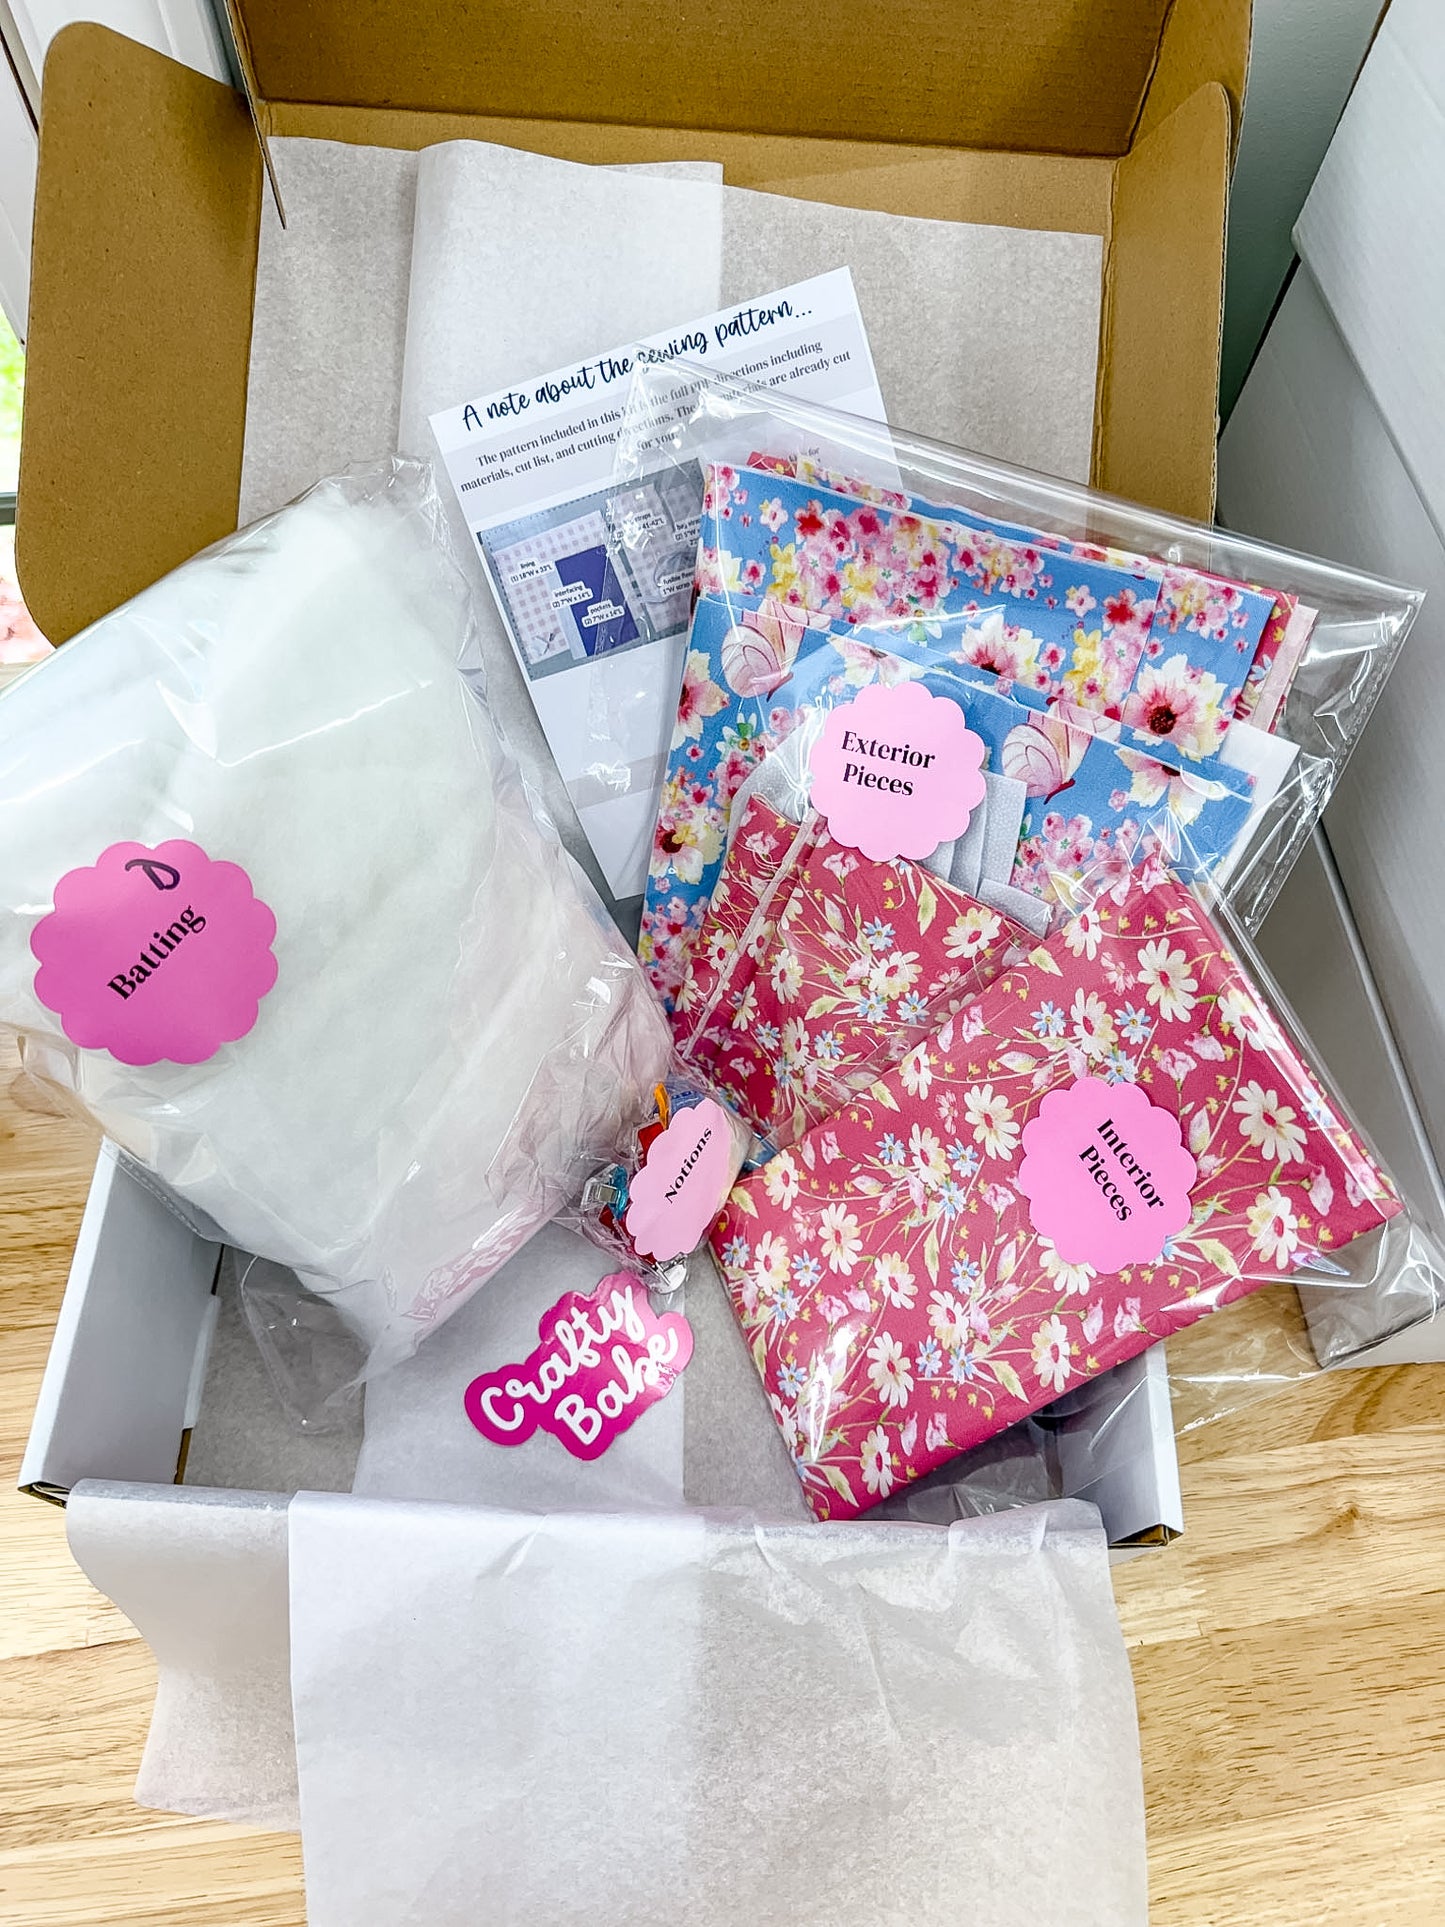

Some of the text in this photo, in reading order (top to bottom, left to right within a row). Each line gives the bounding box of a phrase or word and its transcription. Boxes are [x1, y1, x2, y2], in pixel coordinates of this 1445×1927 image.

[460, 467, 514, 493] materials,
[515, 459, 532, 474] cut
[533, 452, 554, 469] list,
[556, 443, 576, 460] and
[577, 431, 616, 453] cutting
[769, 373, 787, 387] are
[789, 357, 831, 380] already
[833, 350, 851, 365] cut
[462, 404, 483, 431] A
[487, 392, 530, 419] note
[535, 366, 595, 404] about
[594, 358, 633, 383] the
[475, 451, 498, 467] The
[499, 438, 540, 463] pattern
[540, 420, 587, 446] included
[588, 417, 599, 430] in
[600, 409, 621, 425] this
[670, 384, 689, 401] full
[770, 341, 823, 366] including
[554, 584, 583, 598] interfacing
[841, 730, 936, 769] Exterior
[842, 763, 914, 796] Pieces
[124, 858, 181, 891] D
[106, 904, 207, 1000] Batting
[664, 1126, 712, 1204] Notions
[1078, 1144, 1132, 1222] Pieces
[1096, 1118, 1165, 1209] Interior
[480, 1285, 646, 1431] Crafty
[554, 1327, 679, 1445] Babe
